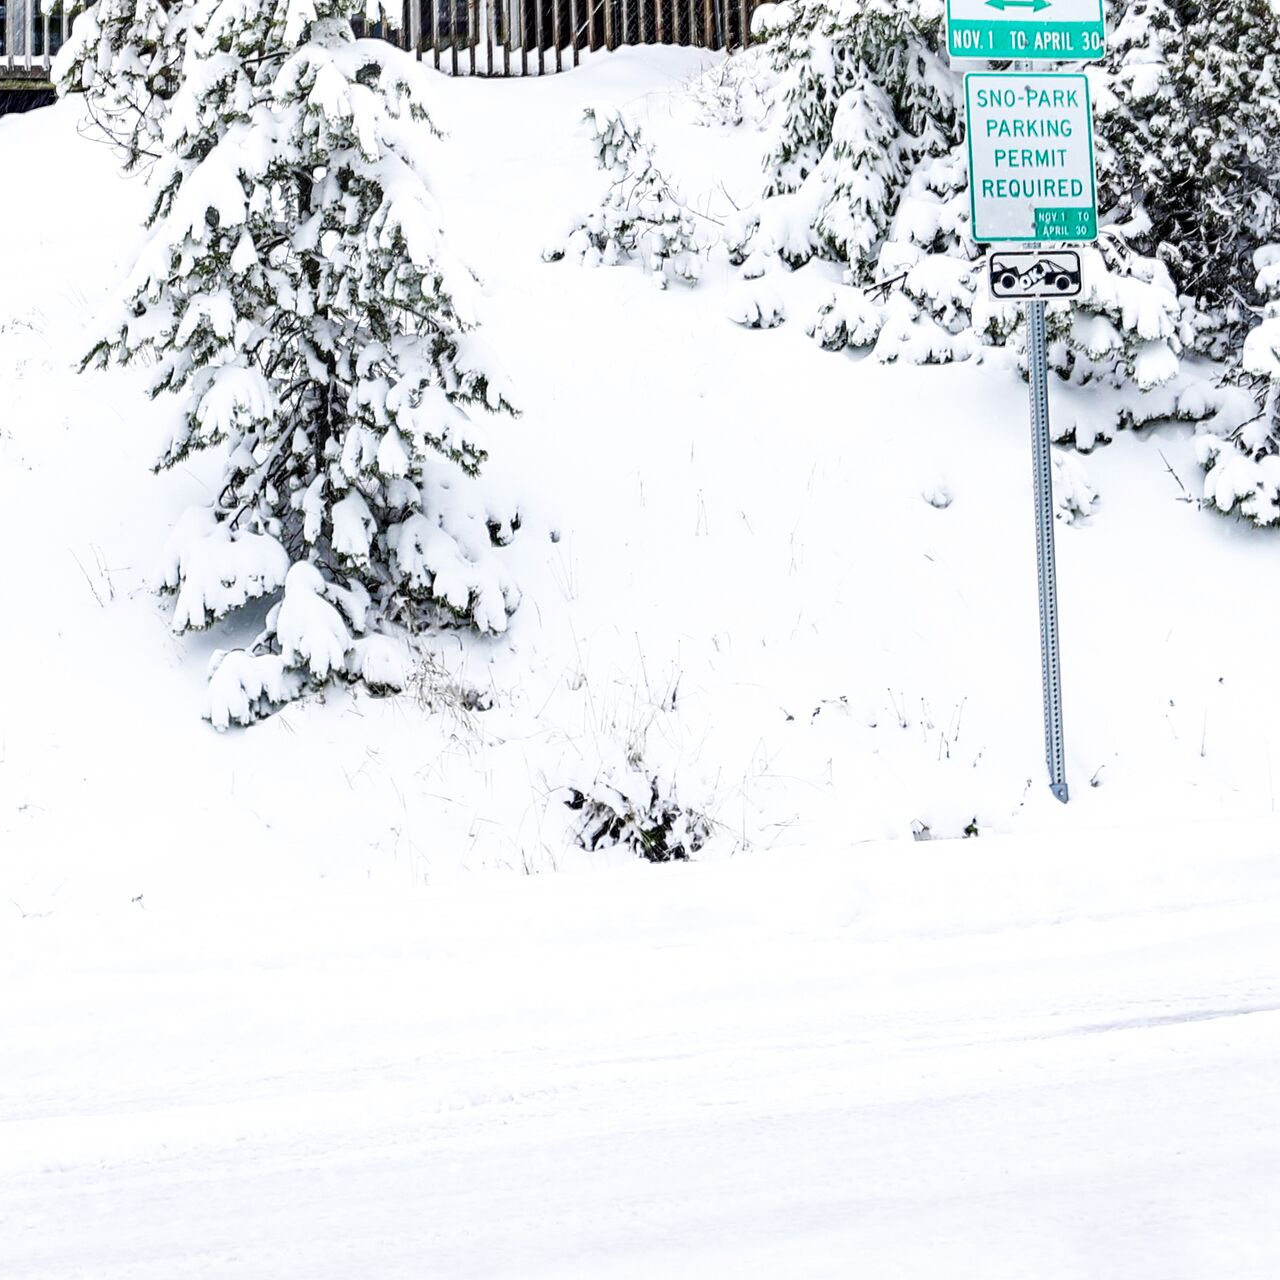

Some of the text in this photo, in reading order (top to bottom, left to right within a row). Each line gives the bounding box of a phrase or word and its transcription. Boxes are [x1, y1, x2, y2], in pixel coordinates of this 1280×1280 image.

[953, 29, 1100, 51] NOV. 1 TO APRIL 30
[977, 89, 1079, 108] SNO-PARK
[986, 119, 1073, 138] PARKING
[994, 149, 1067, 168] PERMIT
[982, 179, 1083, 198] REQUIRED
[1038, 210, 1057, 222] NOV
[1078, 210, 1090, 222] TO
[1043, 225, 1087, 236] APRIL 30
[1019, 267, 1042, 289] OK
